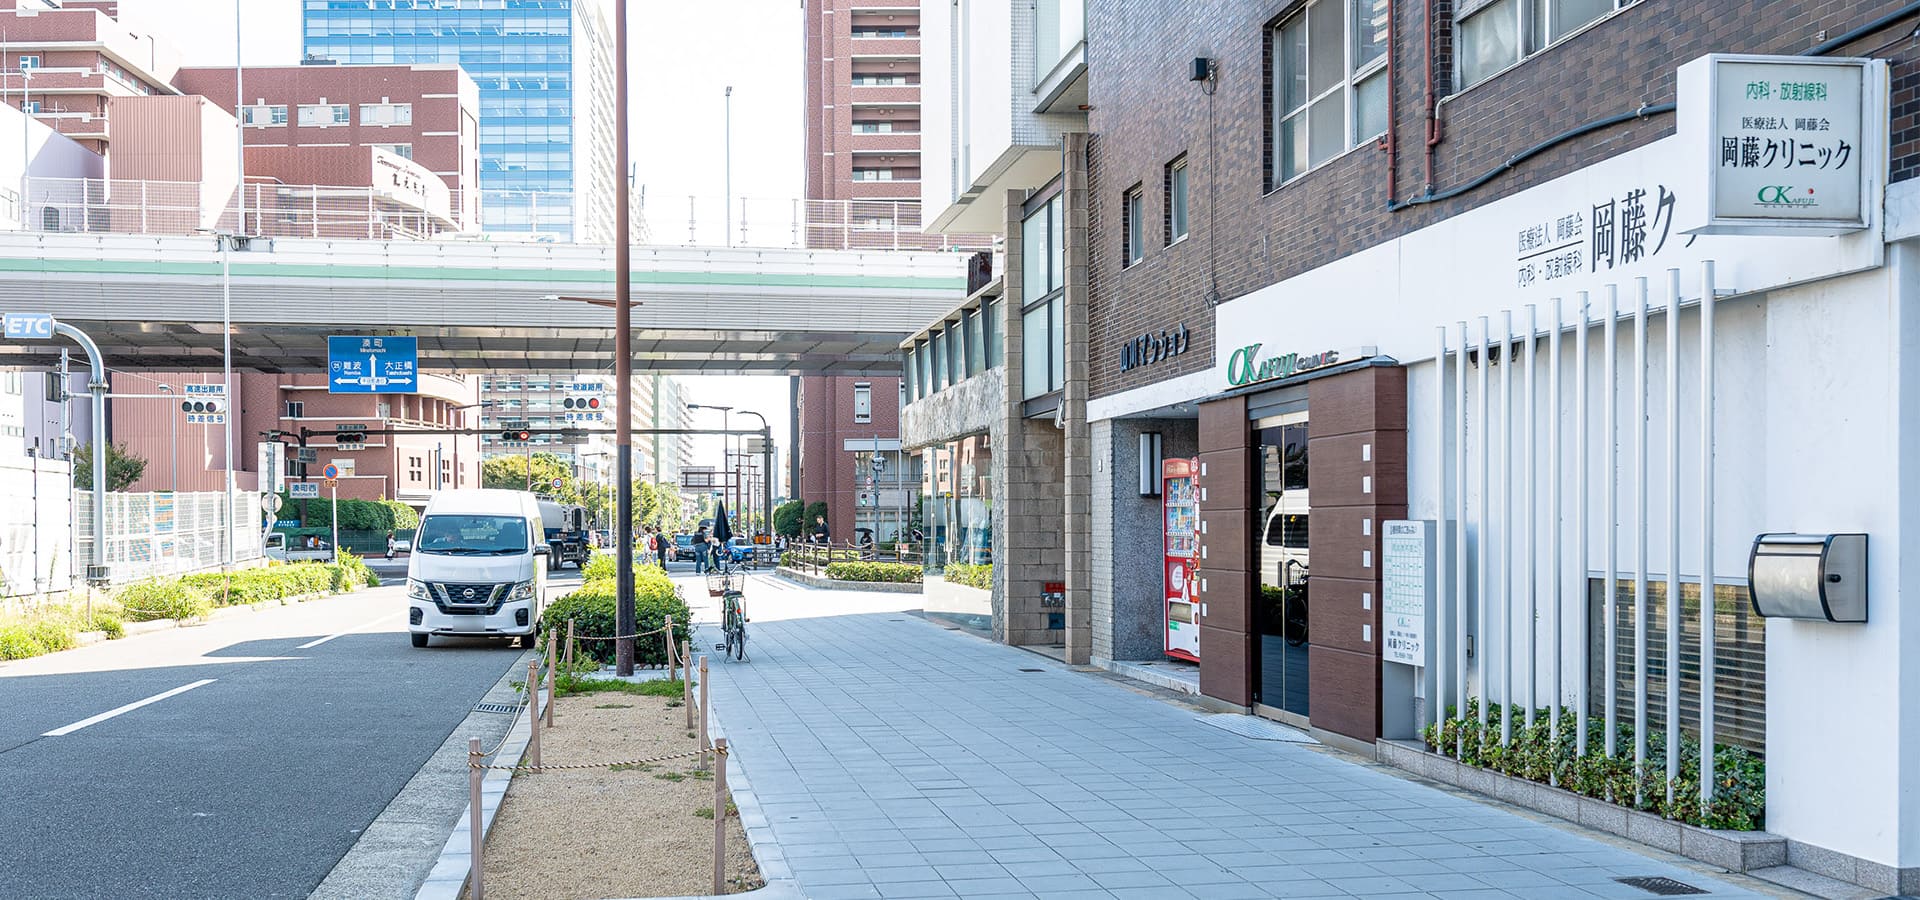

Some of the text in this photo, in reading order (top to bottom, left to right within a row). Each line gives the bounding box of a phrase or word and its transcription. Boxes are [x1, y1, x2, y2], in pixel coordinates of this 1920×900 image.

[1746, 81, 1828, 101] 内科・放射線科
[1742, 116, 1831, 131] 医療法人 岡藤会
[1721, 136, 1851, 170] 岡藤クリニック
[1518, 212, 1584, 254] 医療法人 岡藤会
[1592, 184, 1697, 273] 岡藤ク
[1517, 249, 1583, 288] 内科・放射線科
[8, 318, 50, 334] ETC
[384, 361, 413, 370] 大正橋
[565, 383, 603, 391] 一般道路用
[566, 413, 603, 421] 時差信号
